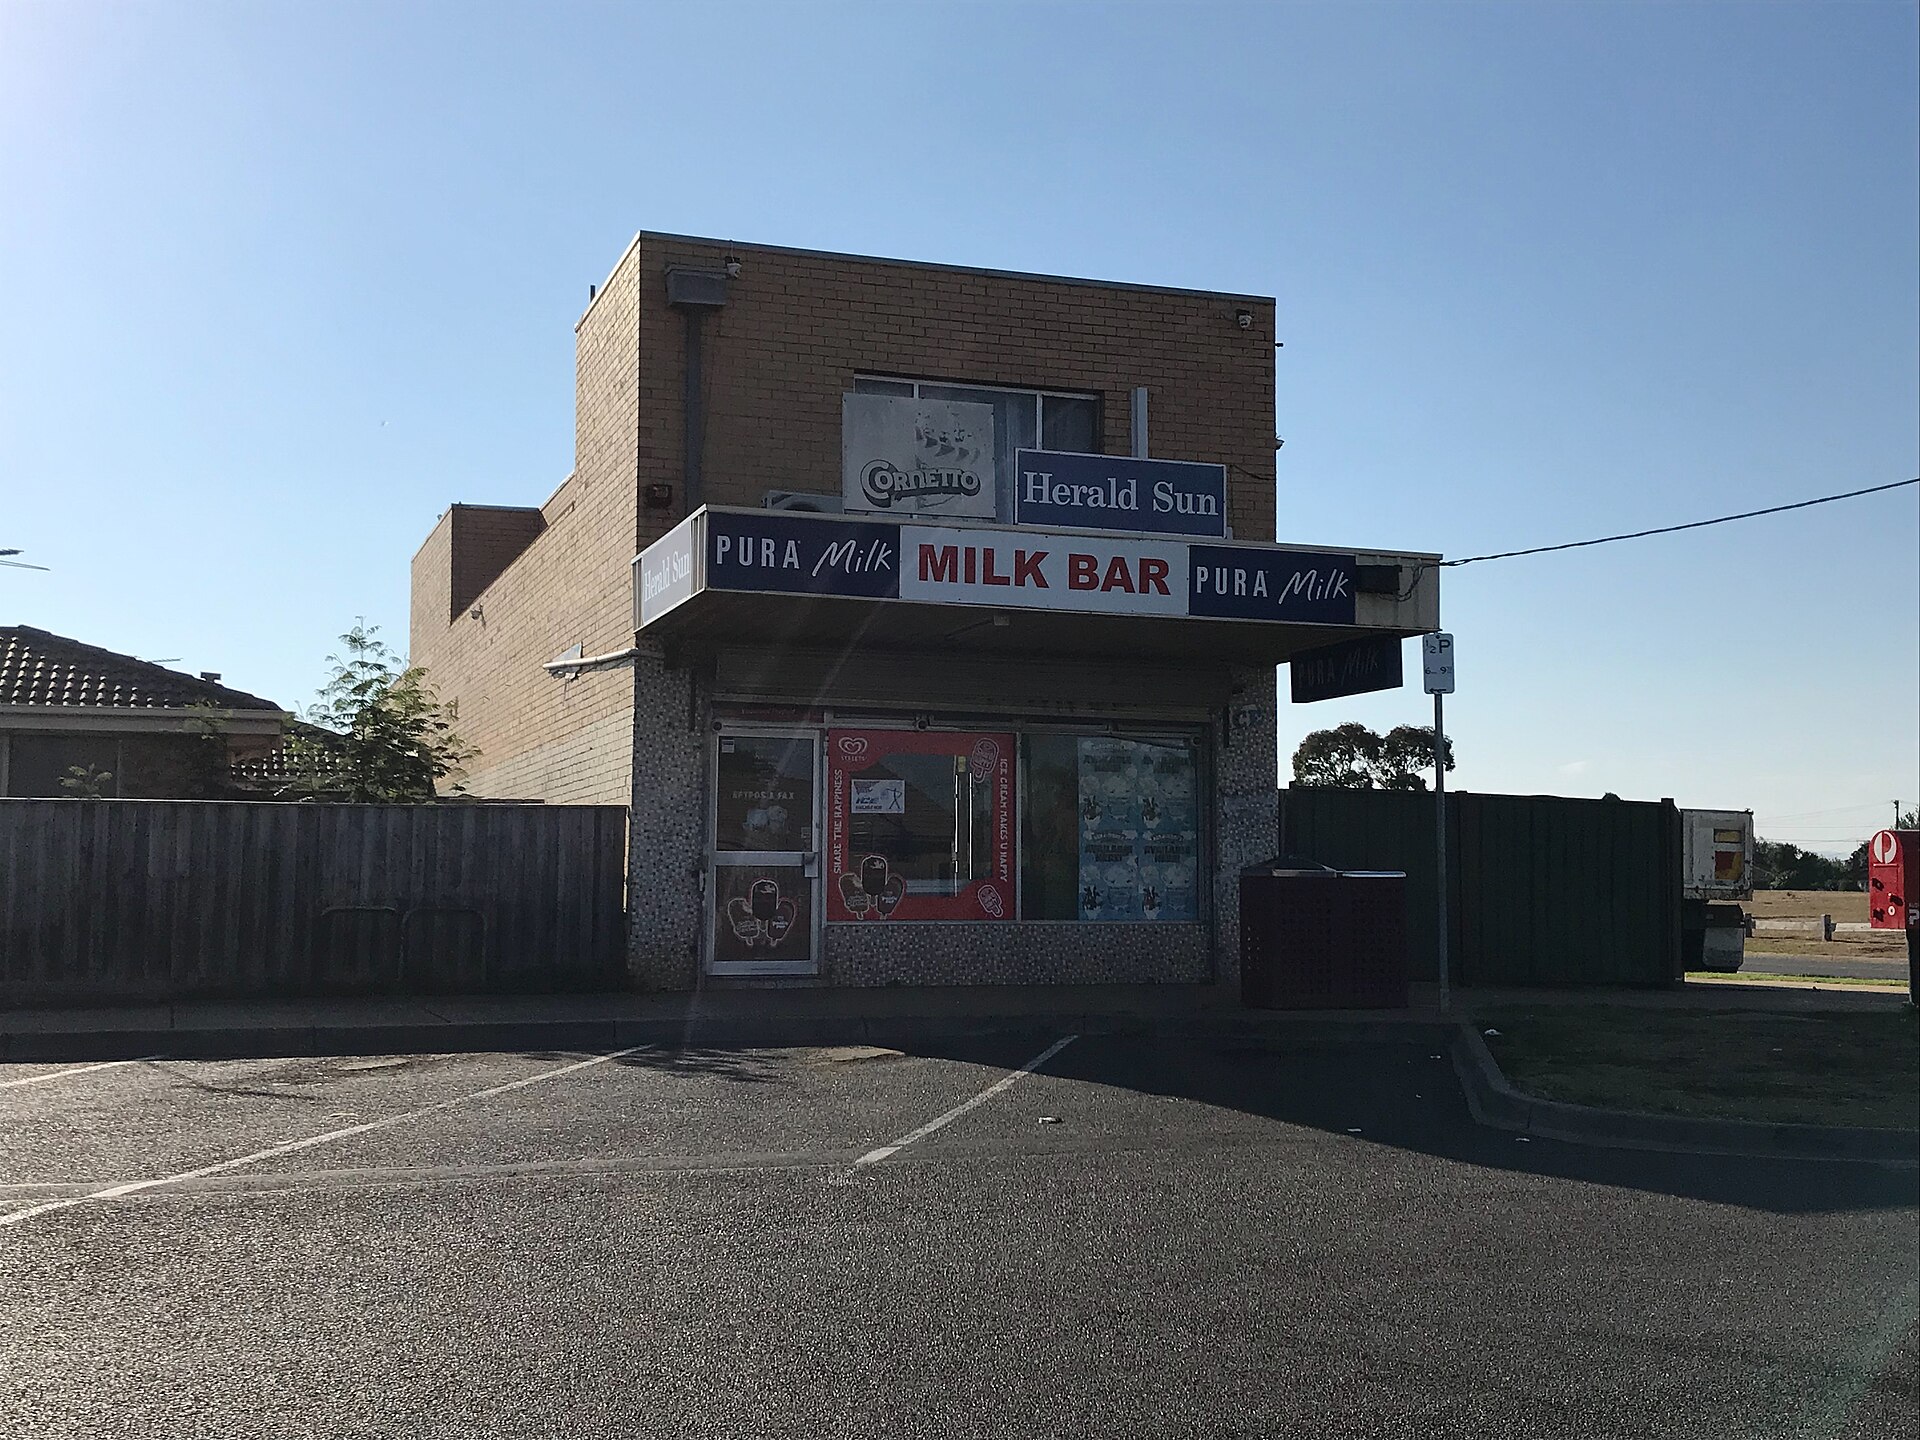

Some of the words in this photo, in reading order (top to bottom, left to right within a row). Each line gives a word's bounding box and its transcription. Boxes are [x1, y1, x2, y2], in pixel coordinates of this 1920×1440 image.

[1023, 471, 1139, 510] Herald
[1152, 481, 1219, 516] Sun
[716, 535, 800, 569] PURA
[811, 539, 892, 577] Milk
[918, 543, 1050, 589] MILK
[1068, 553, 1171, 596] BAR
[643, 558, 671, 602] Herald
[671, 551, 690, 582] Sun
[1196, 566, 1268, 598] PURA
[1278, 569, 1349, 605] Milk
[999, 758, 1007, 775] ICE
[833, 769, 843, 819] HAPPINESS
[999, 776, 1008, 808] CREAM
[833, 821, 842, 841] THE
[999, 809, 1008, 840] MAKES
[833, 843, 842, 874] SHARE
[999, 850, 1008, 882] HAPPY
